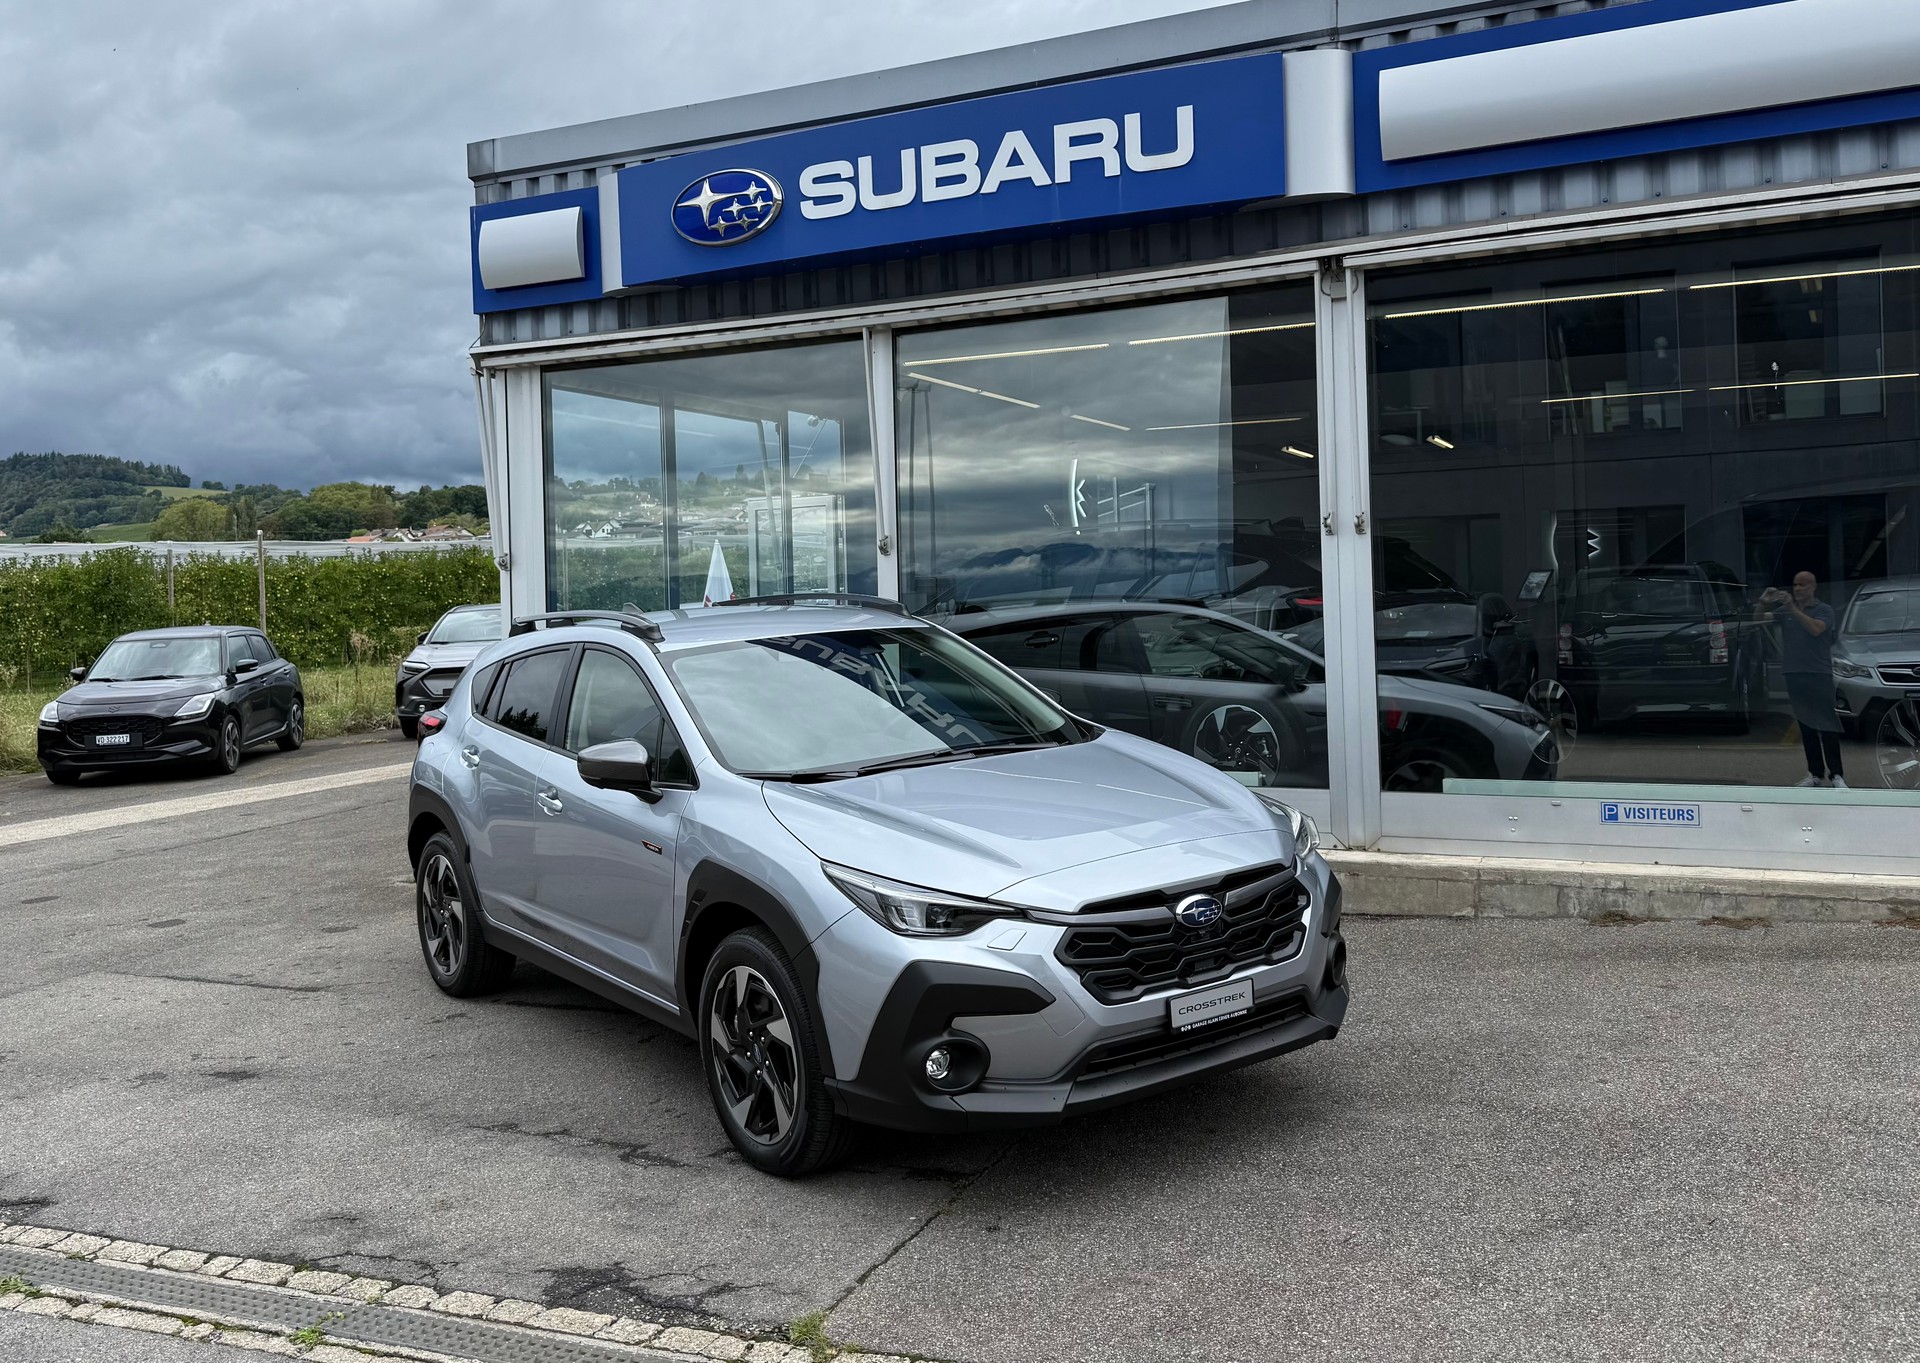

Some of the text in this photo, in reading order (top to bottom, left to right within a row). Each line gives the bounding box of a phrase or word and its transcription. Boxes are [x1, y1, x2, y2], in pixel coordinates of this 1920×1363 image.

[799, 105, 1194, 220] SUBARU
[1605, 805, 1695, 821] P VISITEURS
[1178, 991, 1246, 1015] CROSSTREK
[1192, 1020, 1207, 1028] GARAGE
